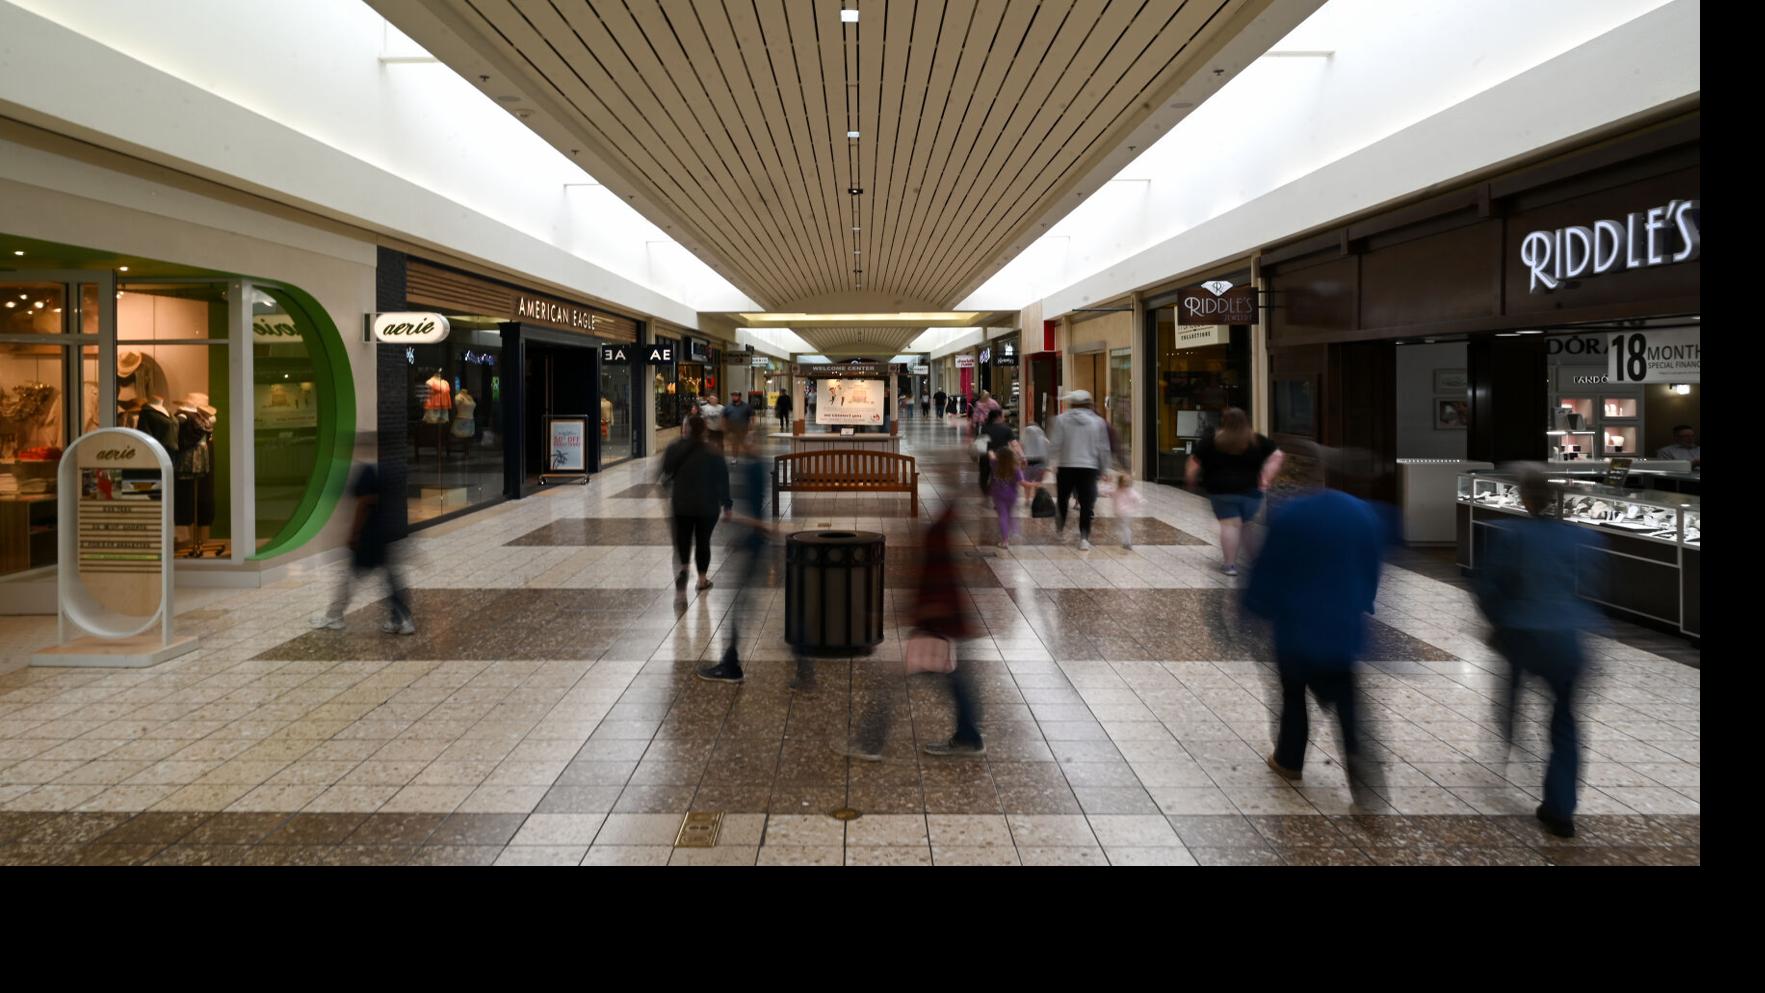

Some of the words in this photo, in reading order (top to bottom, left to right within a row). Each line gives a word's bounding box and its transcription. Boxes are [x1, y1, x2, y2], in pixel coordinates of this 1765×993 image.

[1521, 200, 1696, 294] RIDDLE'S
[518, 296, 569, 324] AMERICAN
[573, 310, 596, 331] EAGLE
[1184, 296, 1253, 317] RIDDLE'S
[382, 316, 435, 336] aerie
[650, 349, 671, 361] AE
[1611, 333, 1648, 382] 18
[1648, 361, 1674, 369] SPECIAL
[96, 445, 136, 460] aerie
